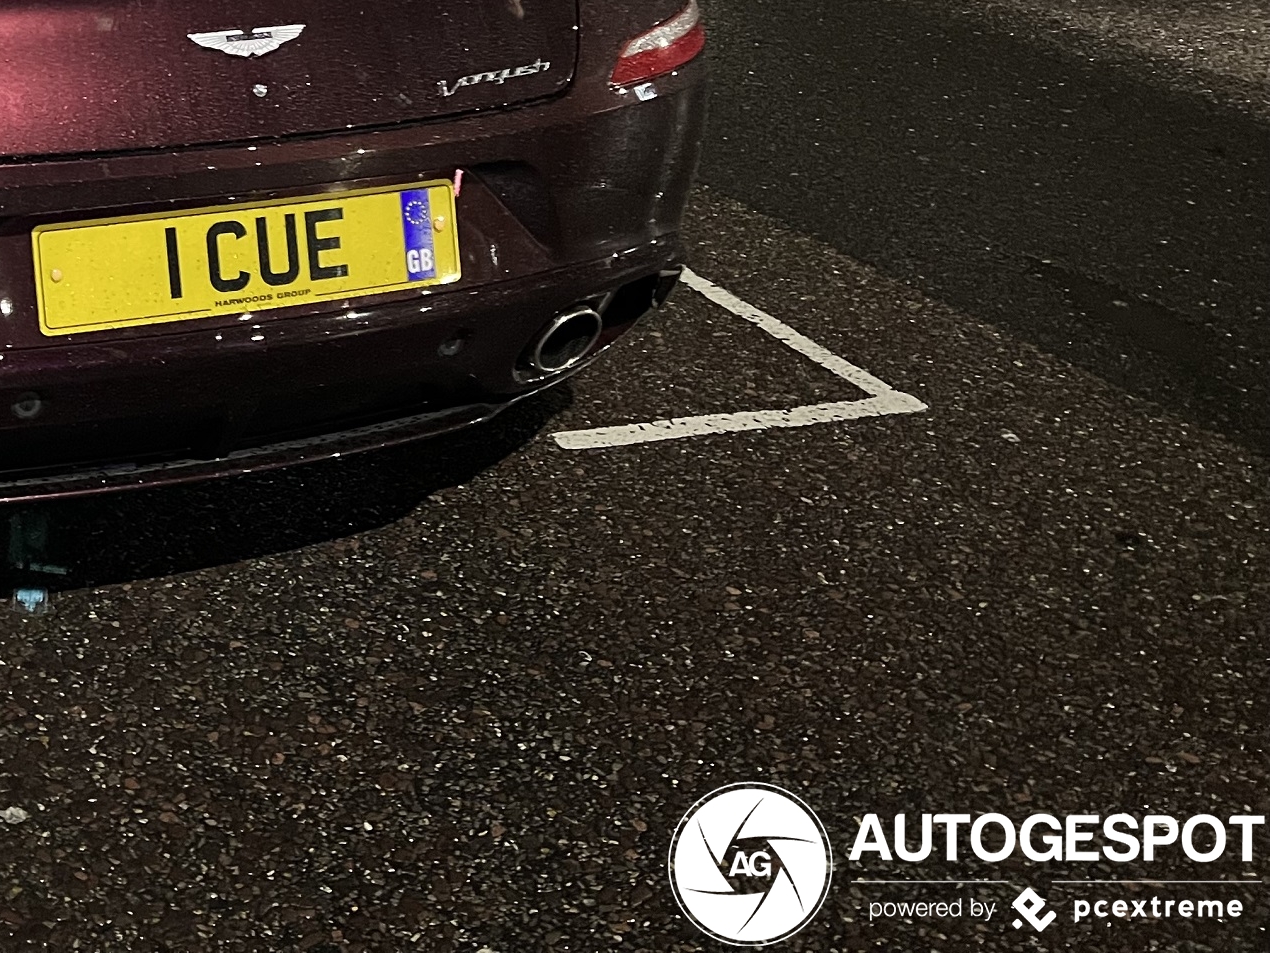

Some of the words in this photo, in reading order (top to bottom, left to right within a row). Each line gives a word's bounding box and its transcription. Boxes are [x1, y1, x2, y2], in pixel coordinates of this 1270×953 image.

[406, 249, 434, 274] GB
[214, 293, 273, 307] HARWOODS
[276, 288, 311, 300] GROUP
